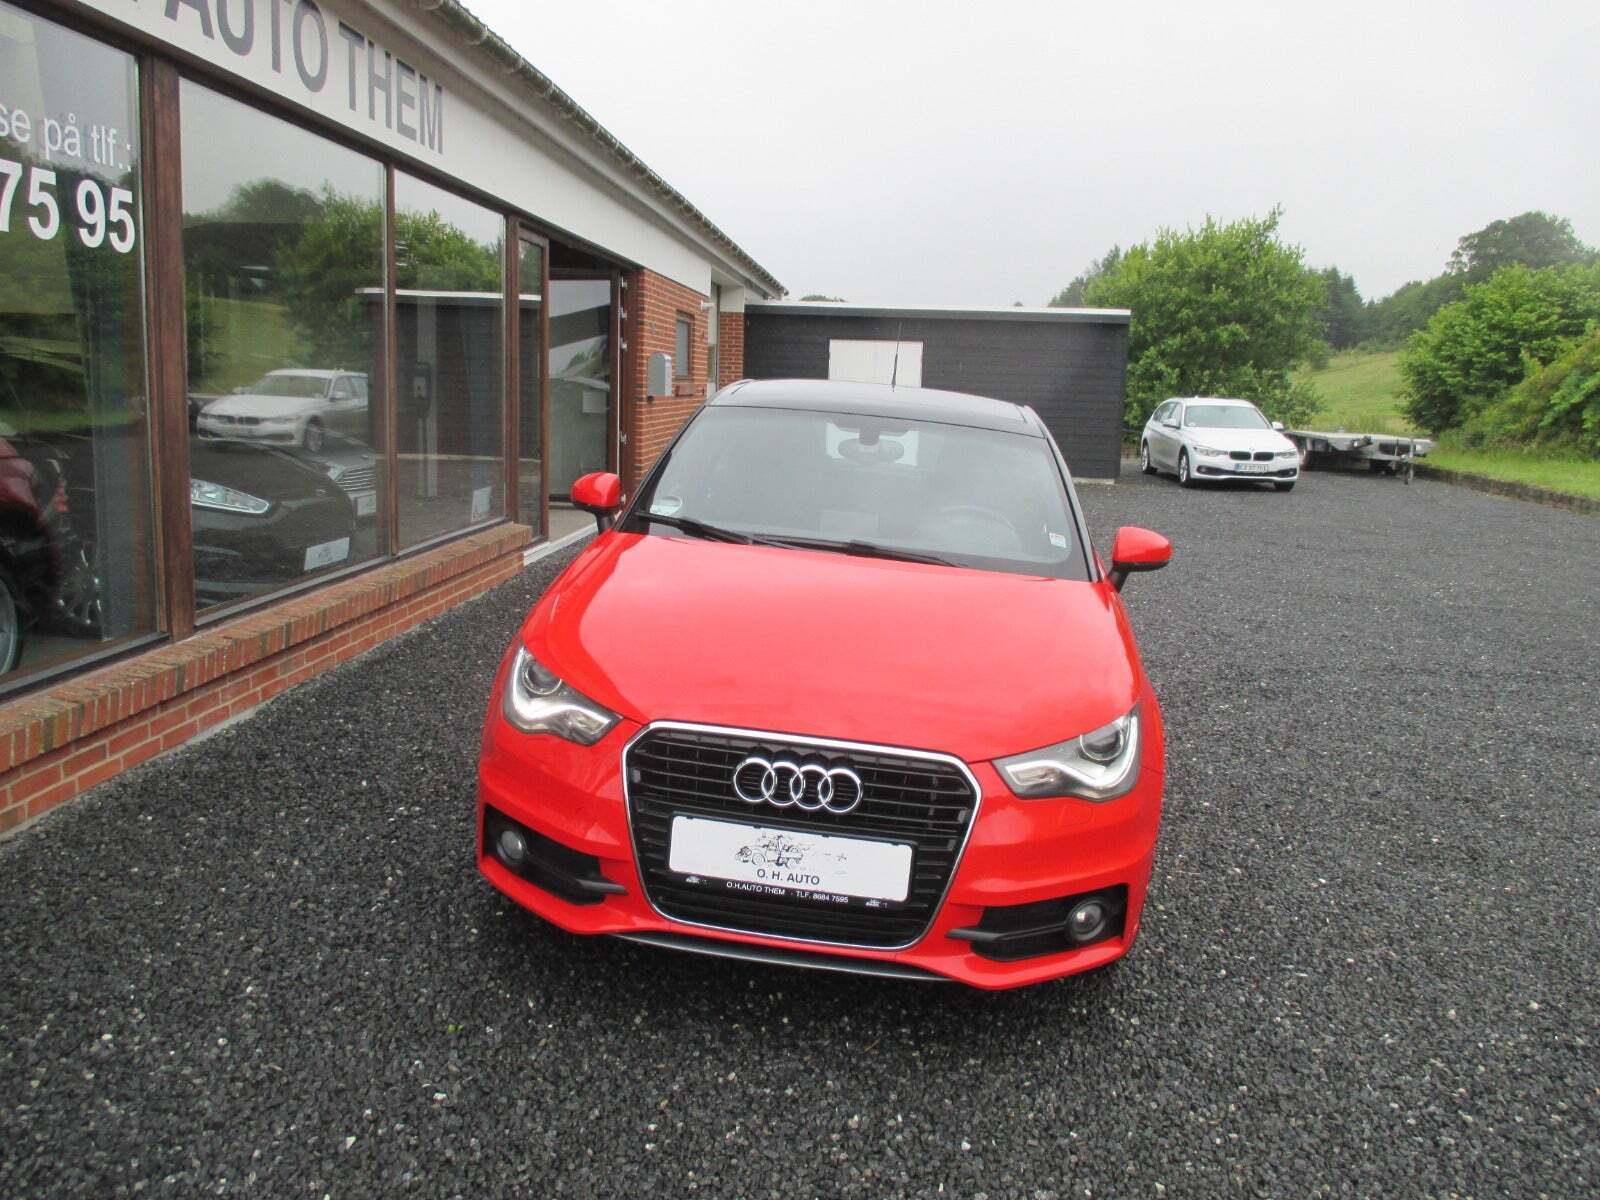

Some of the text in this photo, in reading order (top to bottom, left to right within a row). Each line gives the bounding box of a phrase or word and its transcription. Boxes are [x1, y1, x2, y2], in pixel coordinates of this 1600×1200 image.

[339, 20, 444, 154] THEM
[44, 112, 82, 161] på
[91, 124, 132, 172] tlf.:
[0, 157, 136, 254] 75 95
[757, 868, 820, 885] O. H. AUTO
[764, 886, 786, 896] THEM
